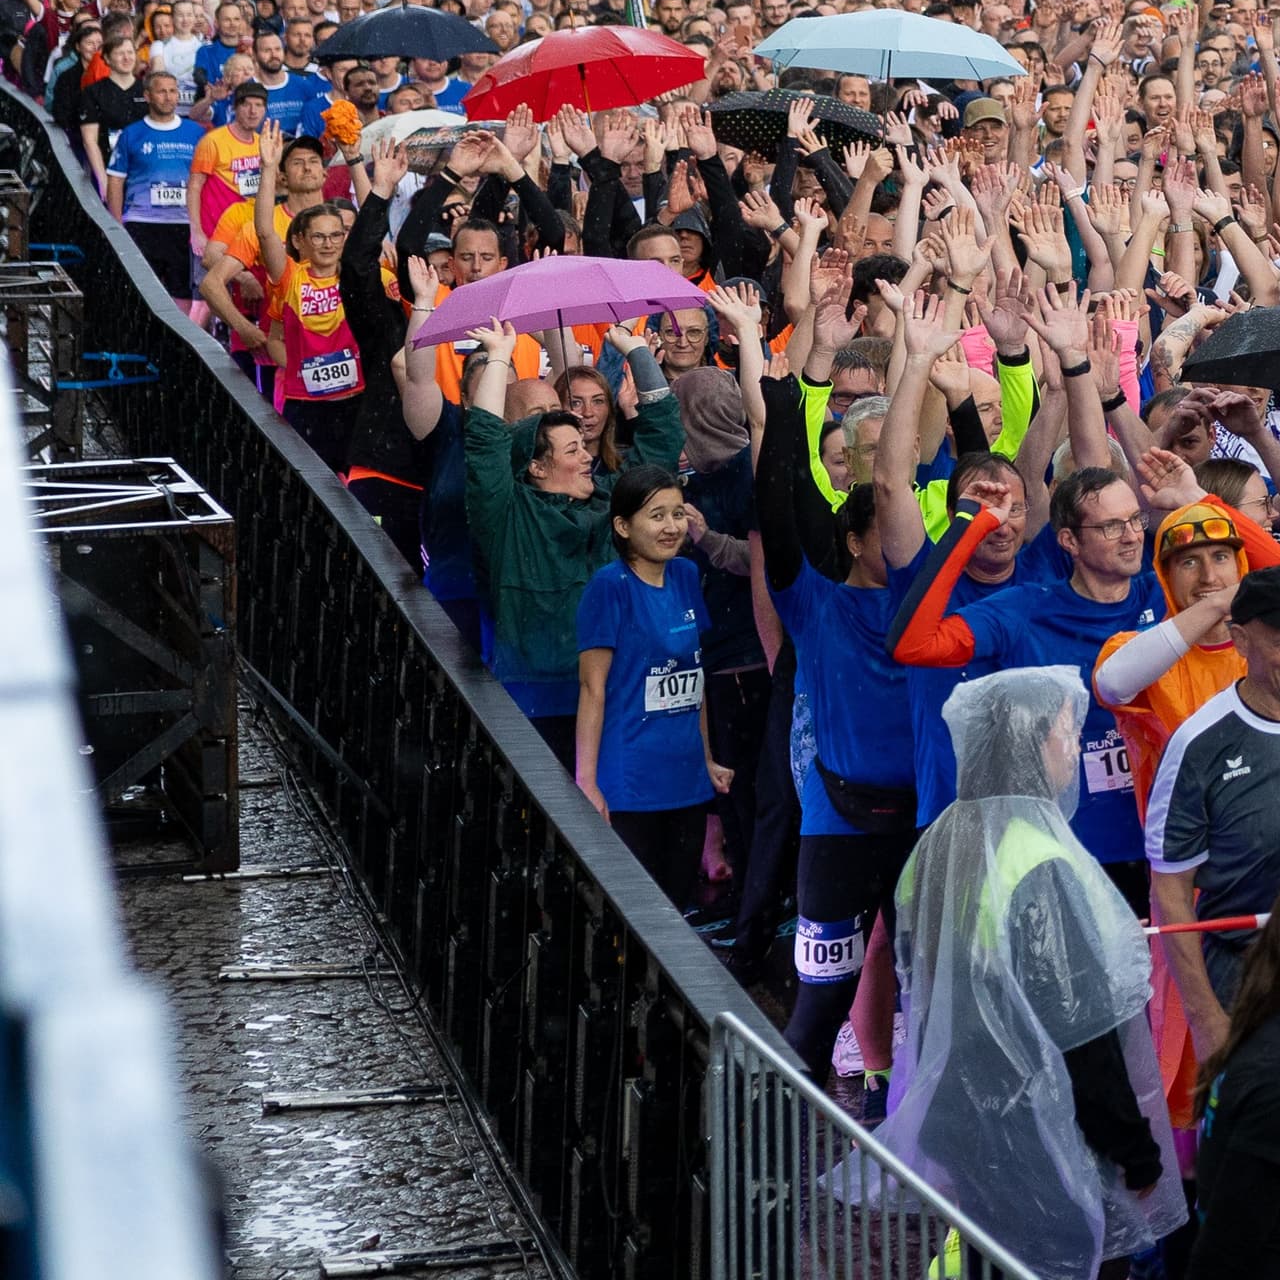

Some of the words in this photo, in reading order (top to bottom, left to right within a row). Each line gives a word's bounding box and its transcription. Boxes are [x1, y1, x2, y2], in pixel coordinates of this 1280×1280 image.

[312, 363, 350, 383] 4380
[650, 666, 672, 676] RUN
[658, 672, 698, 698] 1077
[1086, 739, 1115, 752] RUN
[1223, 766, 1251, 781] erima
[798, 925, 814, 938] RUN
[803, 938, 853, 965] 1091
